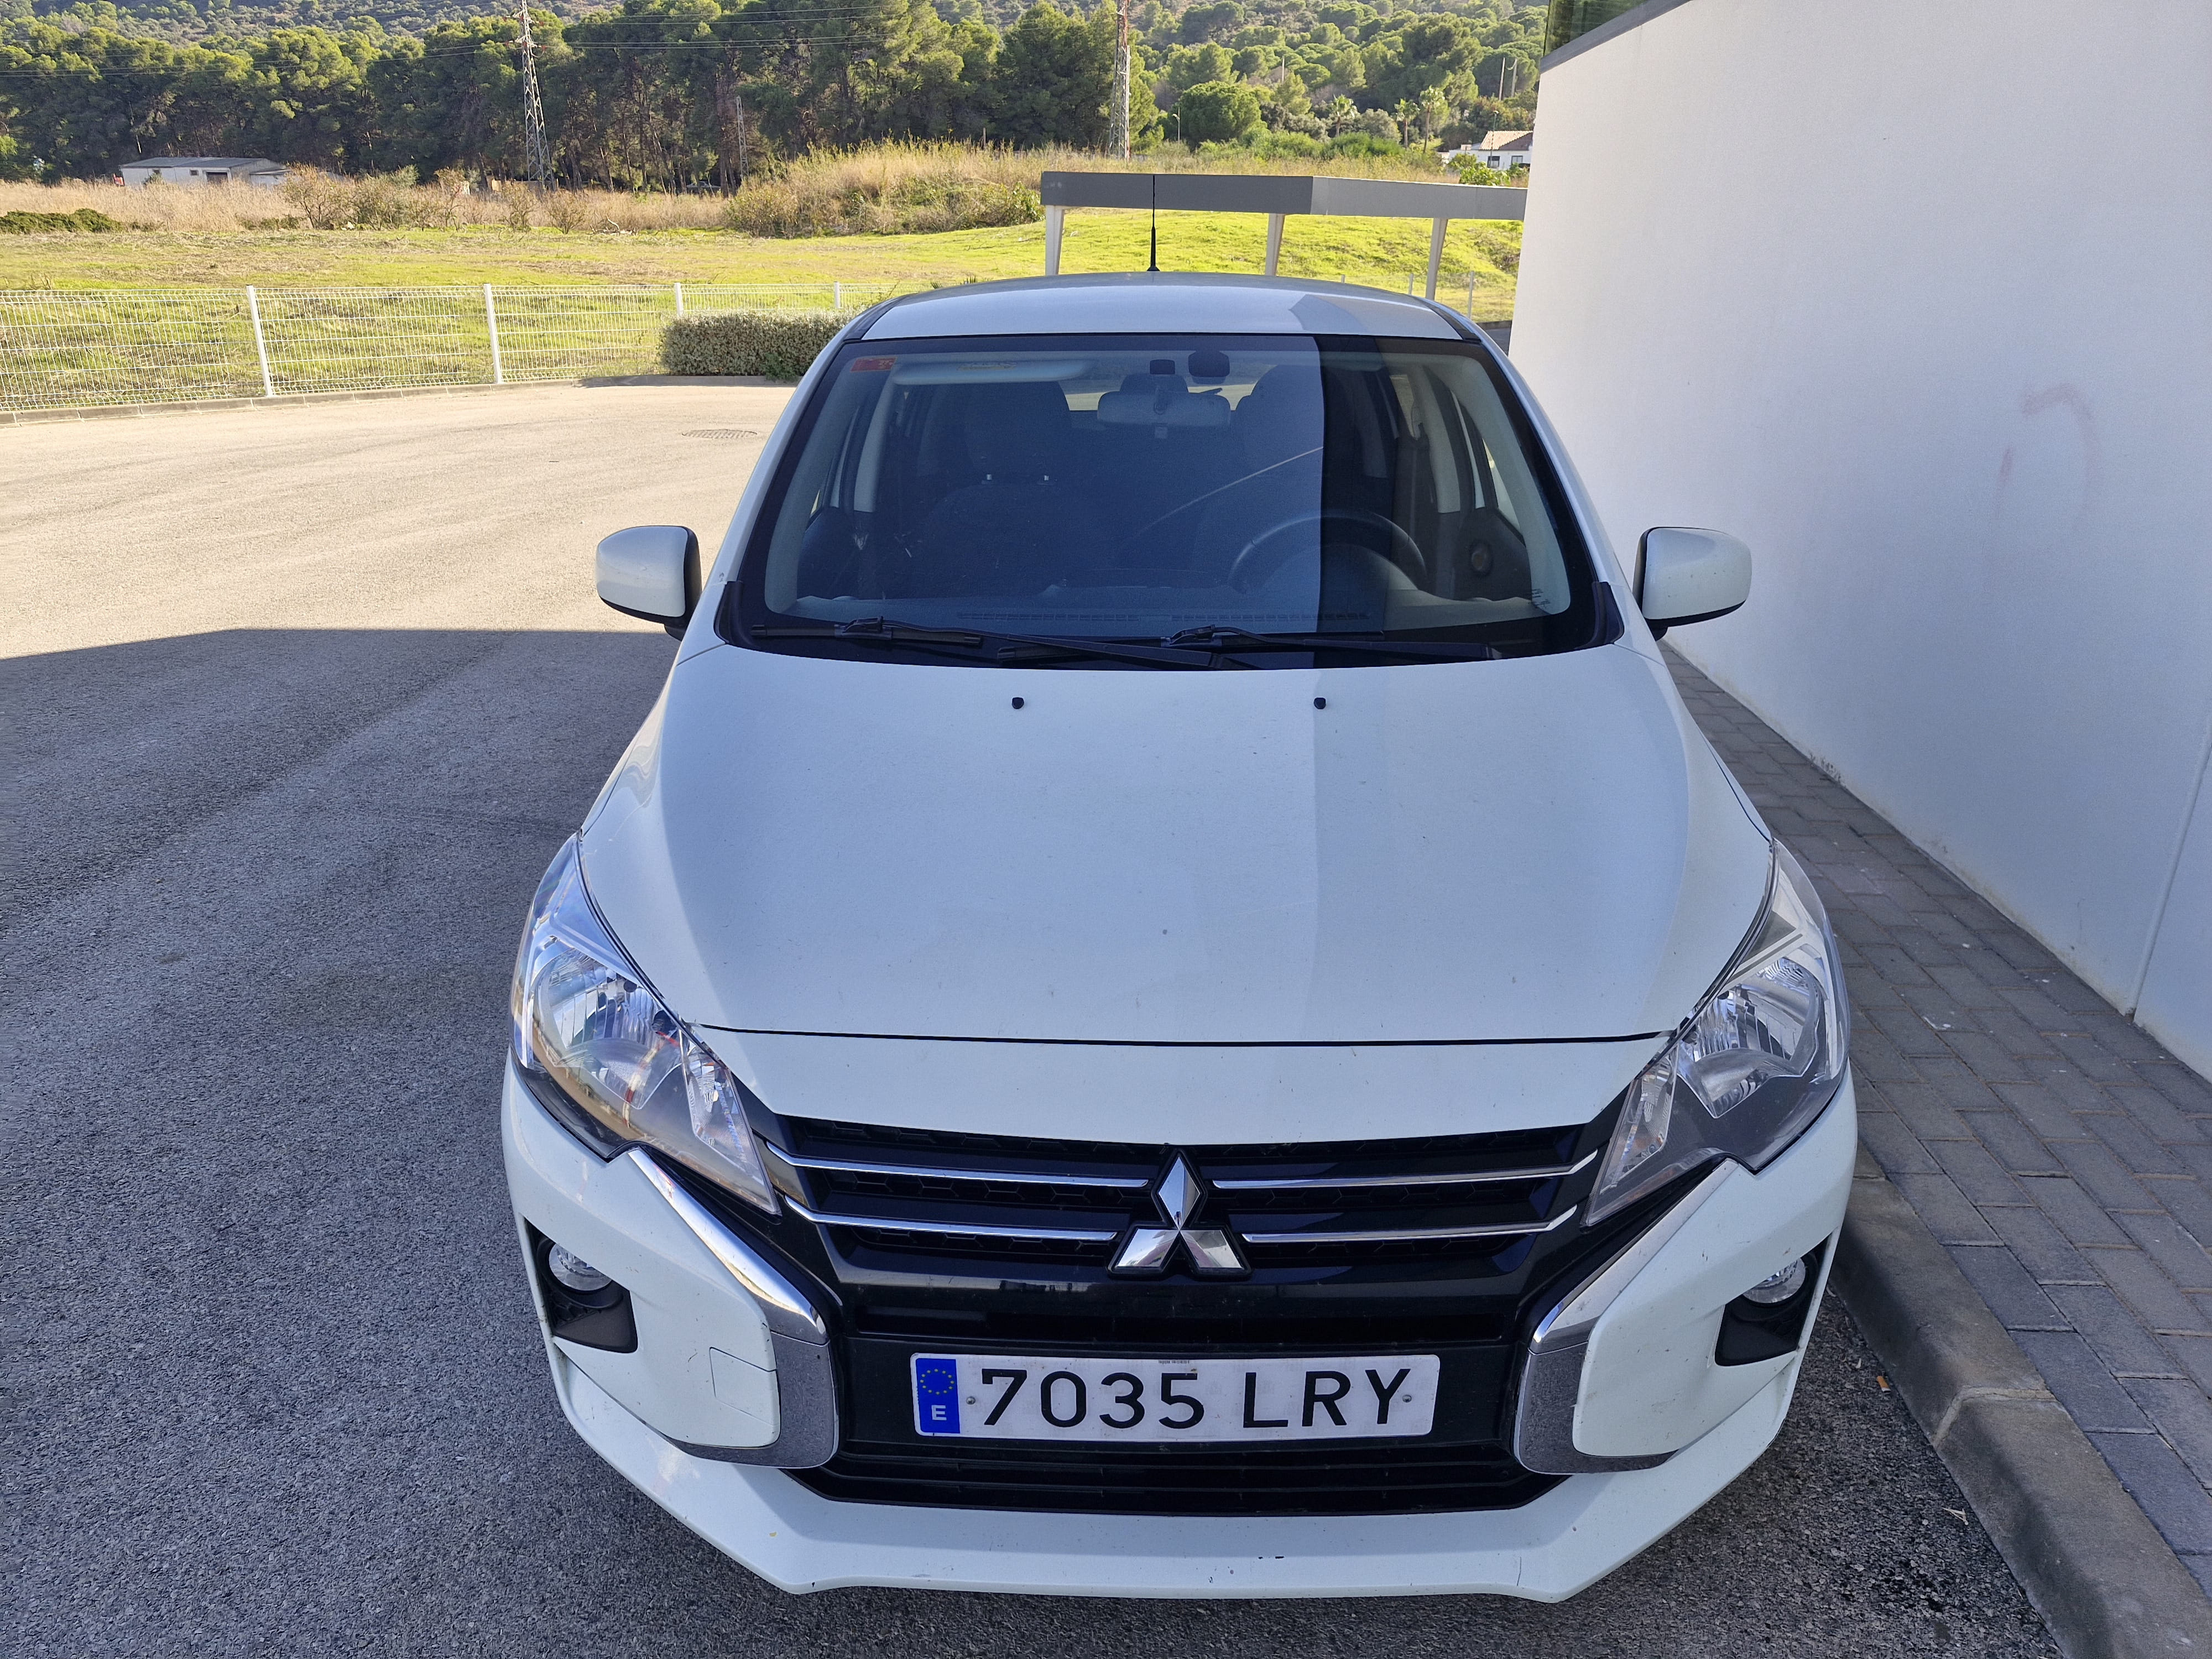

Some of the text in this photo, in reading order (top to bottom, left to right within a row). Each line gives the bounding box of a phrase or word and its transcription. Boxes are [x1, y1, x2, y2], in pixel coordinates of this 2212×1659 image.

[931, 1405, 947, 1421] E
[981, 1368, 1411, 1429] 7035 LRY
